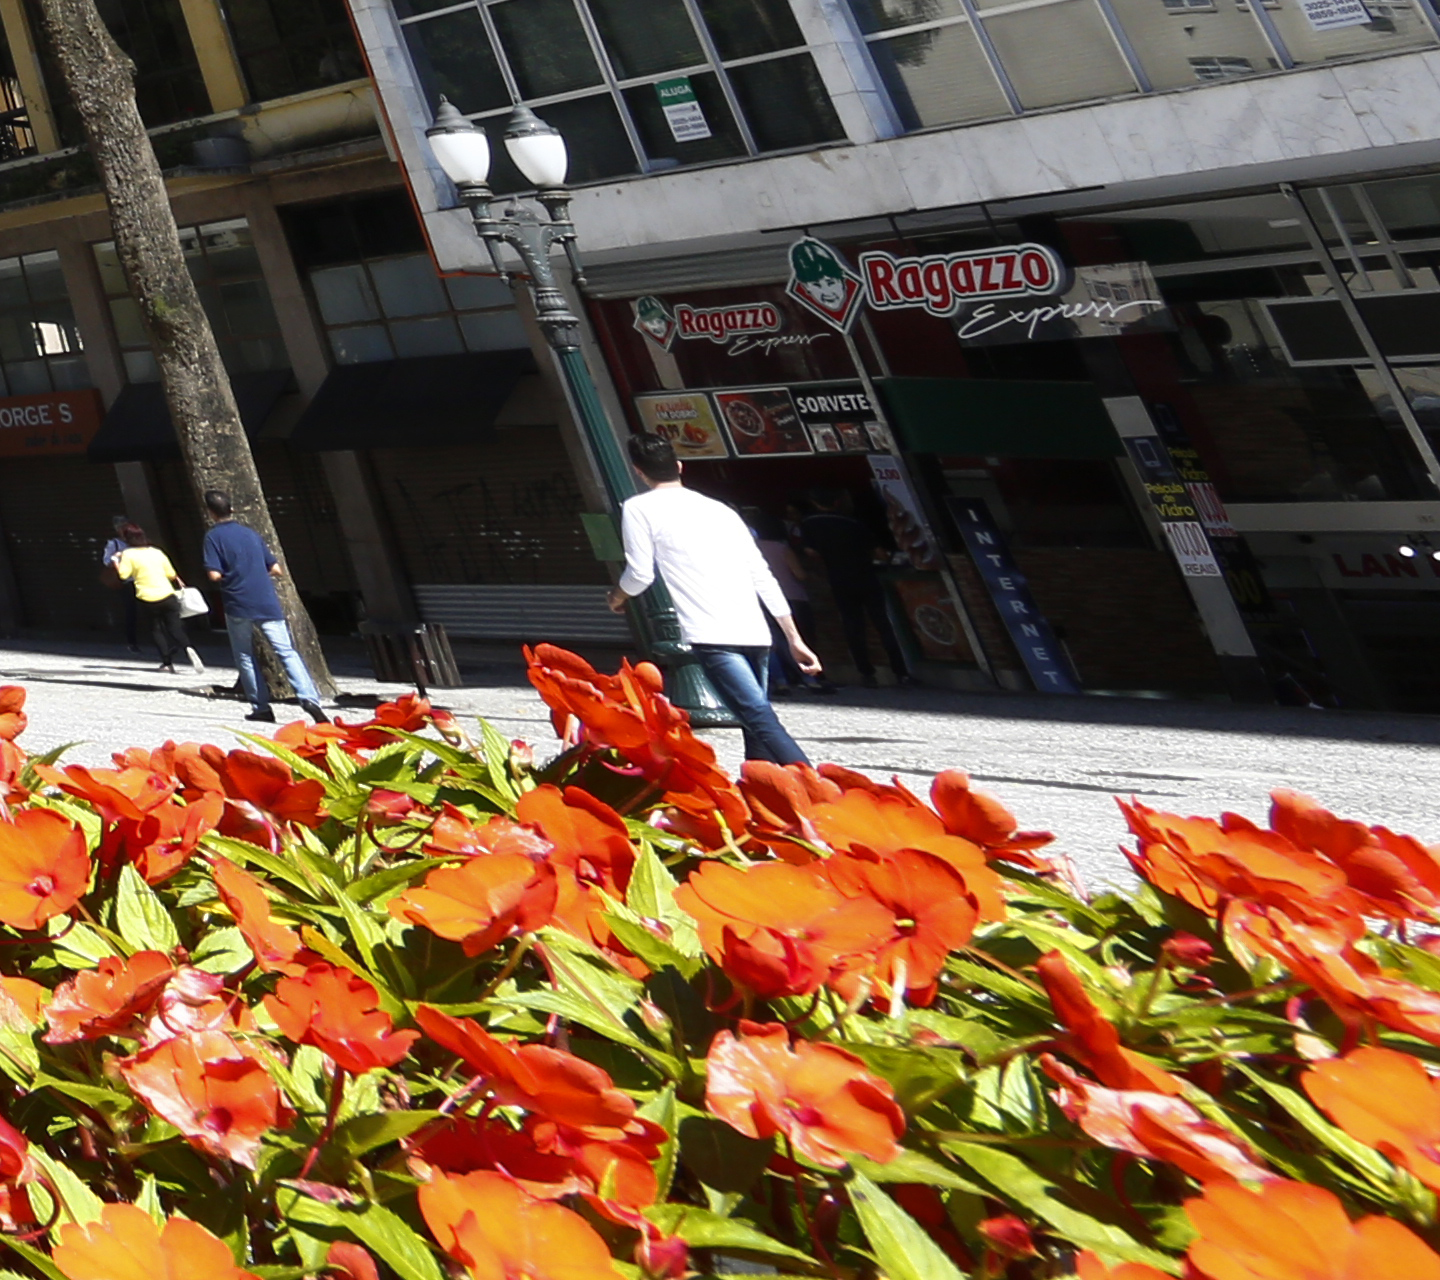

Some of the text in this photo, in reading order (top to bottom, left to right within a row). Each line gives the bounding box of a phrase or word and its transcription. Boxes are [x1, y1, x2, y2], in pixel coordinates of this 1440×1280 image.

[660, 84, 693, 97] ALUGA
[868, 249, 1049, 308] Ragazzo
[679, 309, 776, 337] Ragazzo
[957, 300, 1161, 339] Express
[727, 332, 831, 357] Express
[796, 394, 872, 414] SORVETE
[1154, 503, 1195, 517] Vidro
[1184, 563, 1219, 576] REAIS
[1332, 553, 1419, 578] LAN
[968, 509, 1058, 685] INTERNET
